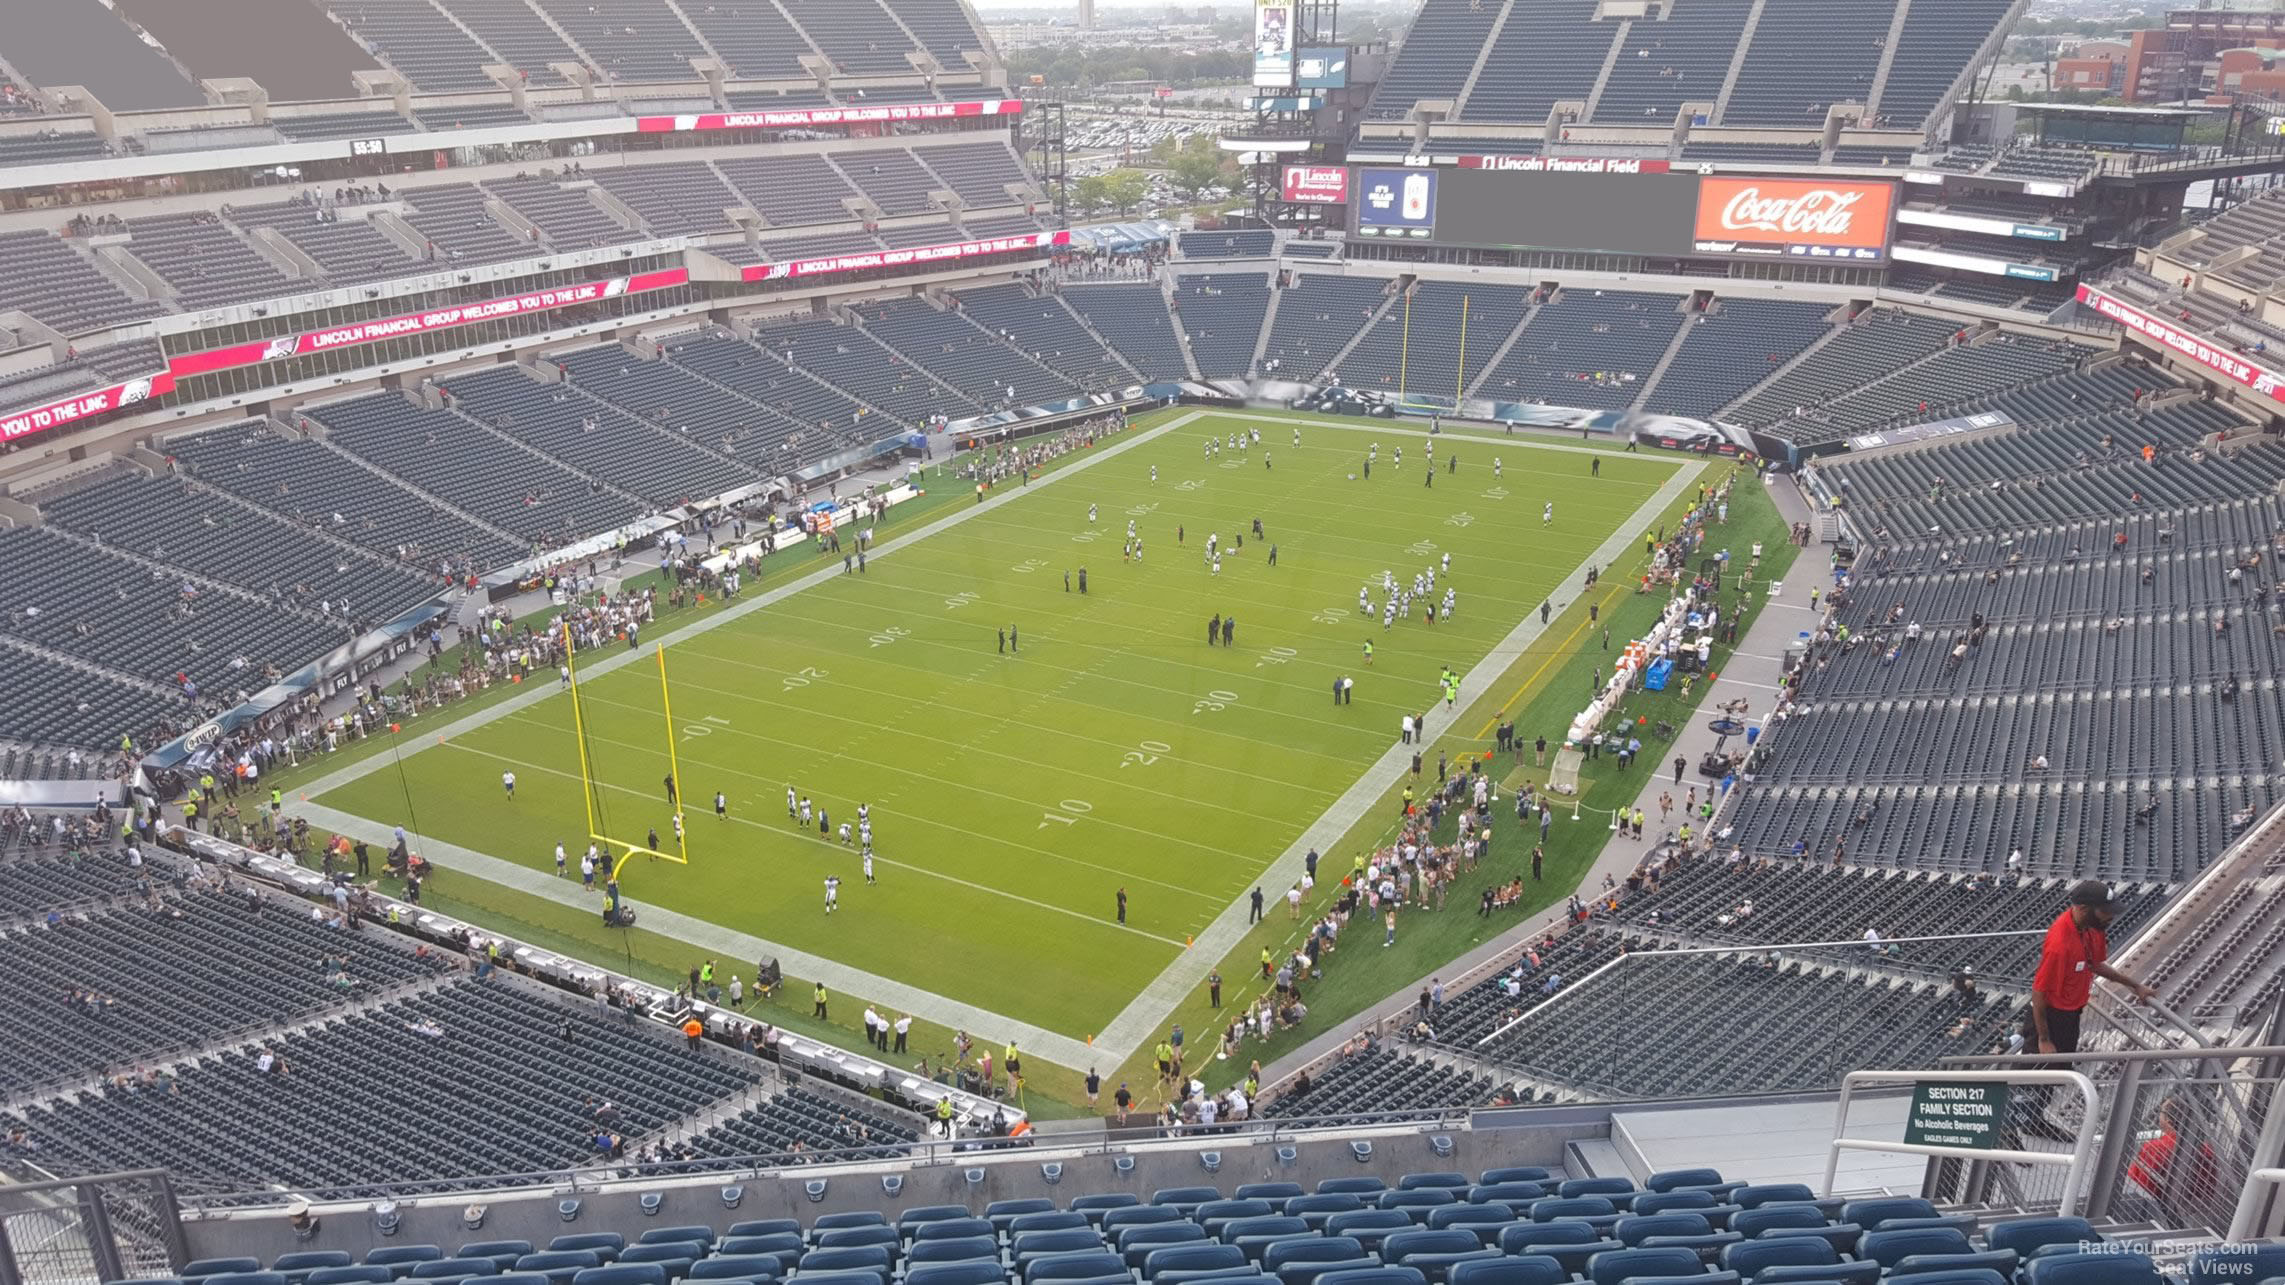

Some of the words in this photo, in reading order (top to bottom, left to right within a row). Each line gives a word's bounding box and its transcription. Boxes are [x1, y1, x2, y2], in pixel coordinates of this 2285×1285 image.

[725, 114, 763, 126] LINCOLN
[1498, 156, 1544, 171] Lincoln
[1546, 158, 1604, 173] Financial
[1607, 159, 1640, 173] Field
[1305, 168, 1342, 181] Lincoln
[798, 258, 835, 273] LINCOLN
[313, 329, 363, 347] LINCOLN
[364, 318, 422, 338] FINANCIAL
[423, 311, 461, 327] GROUP
[463, 300, 519, 319] WELCOMES
[520, 297, 541, 309] YOU
[542, 294, 555, 305] TO
[555, 291, 575, 303] THE
[576, 286, 597, 299] LINC
[1, 417, 31, 437] YOU
[32, 411, 51, 427] TO
[52, 402, 79, 422] THE
[79, 394, 108, 414] LINC
[1312, 608, 1350, 625] 50
[869, 626, 912, 645] 30
[396, 642, 407, 655] FLY
[1261, 647, 1297, 664] 40
[336, 675, 348, 689] FLY
[783, 666, 829, 688] 20
[1194, 690, 1239, 712] 30
[682, 715, 731, 738] 10
[1124, 741, 1171, 766] 20
[1044, 799, 1093, 827] 10
[1928, 1087, 1967, 1100] SECTION
[1968, 1088, 1985, 1100] 217
[1919, 1103, 1950, 1115] FAMILY
[1952, 1104, 1993, 1117] SECTION
[1914, 1119, 1924, 1128] No
[1924, 1119, 1953, 1130] Alcoholic
[1954, 1121, 1989, 1134] Beverages
[1924, 1134, 1942, 1143] EAGLES
[1943, 1135, 1959, 1143] GAMES
[1960, 1136, 1973, 1144] ONLY
